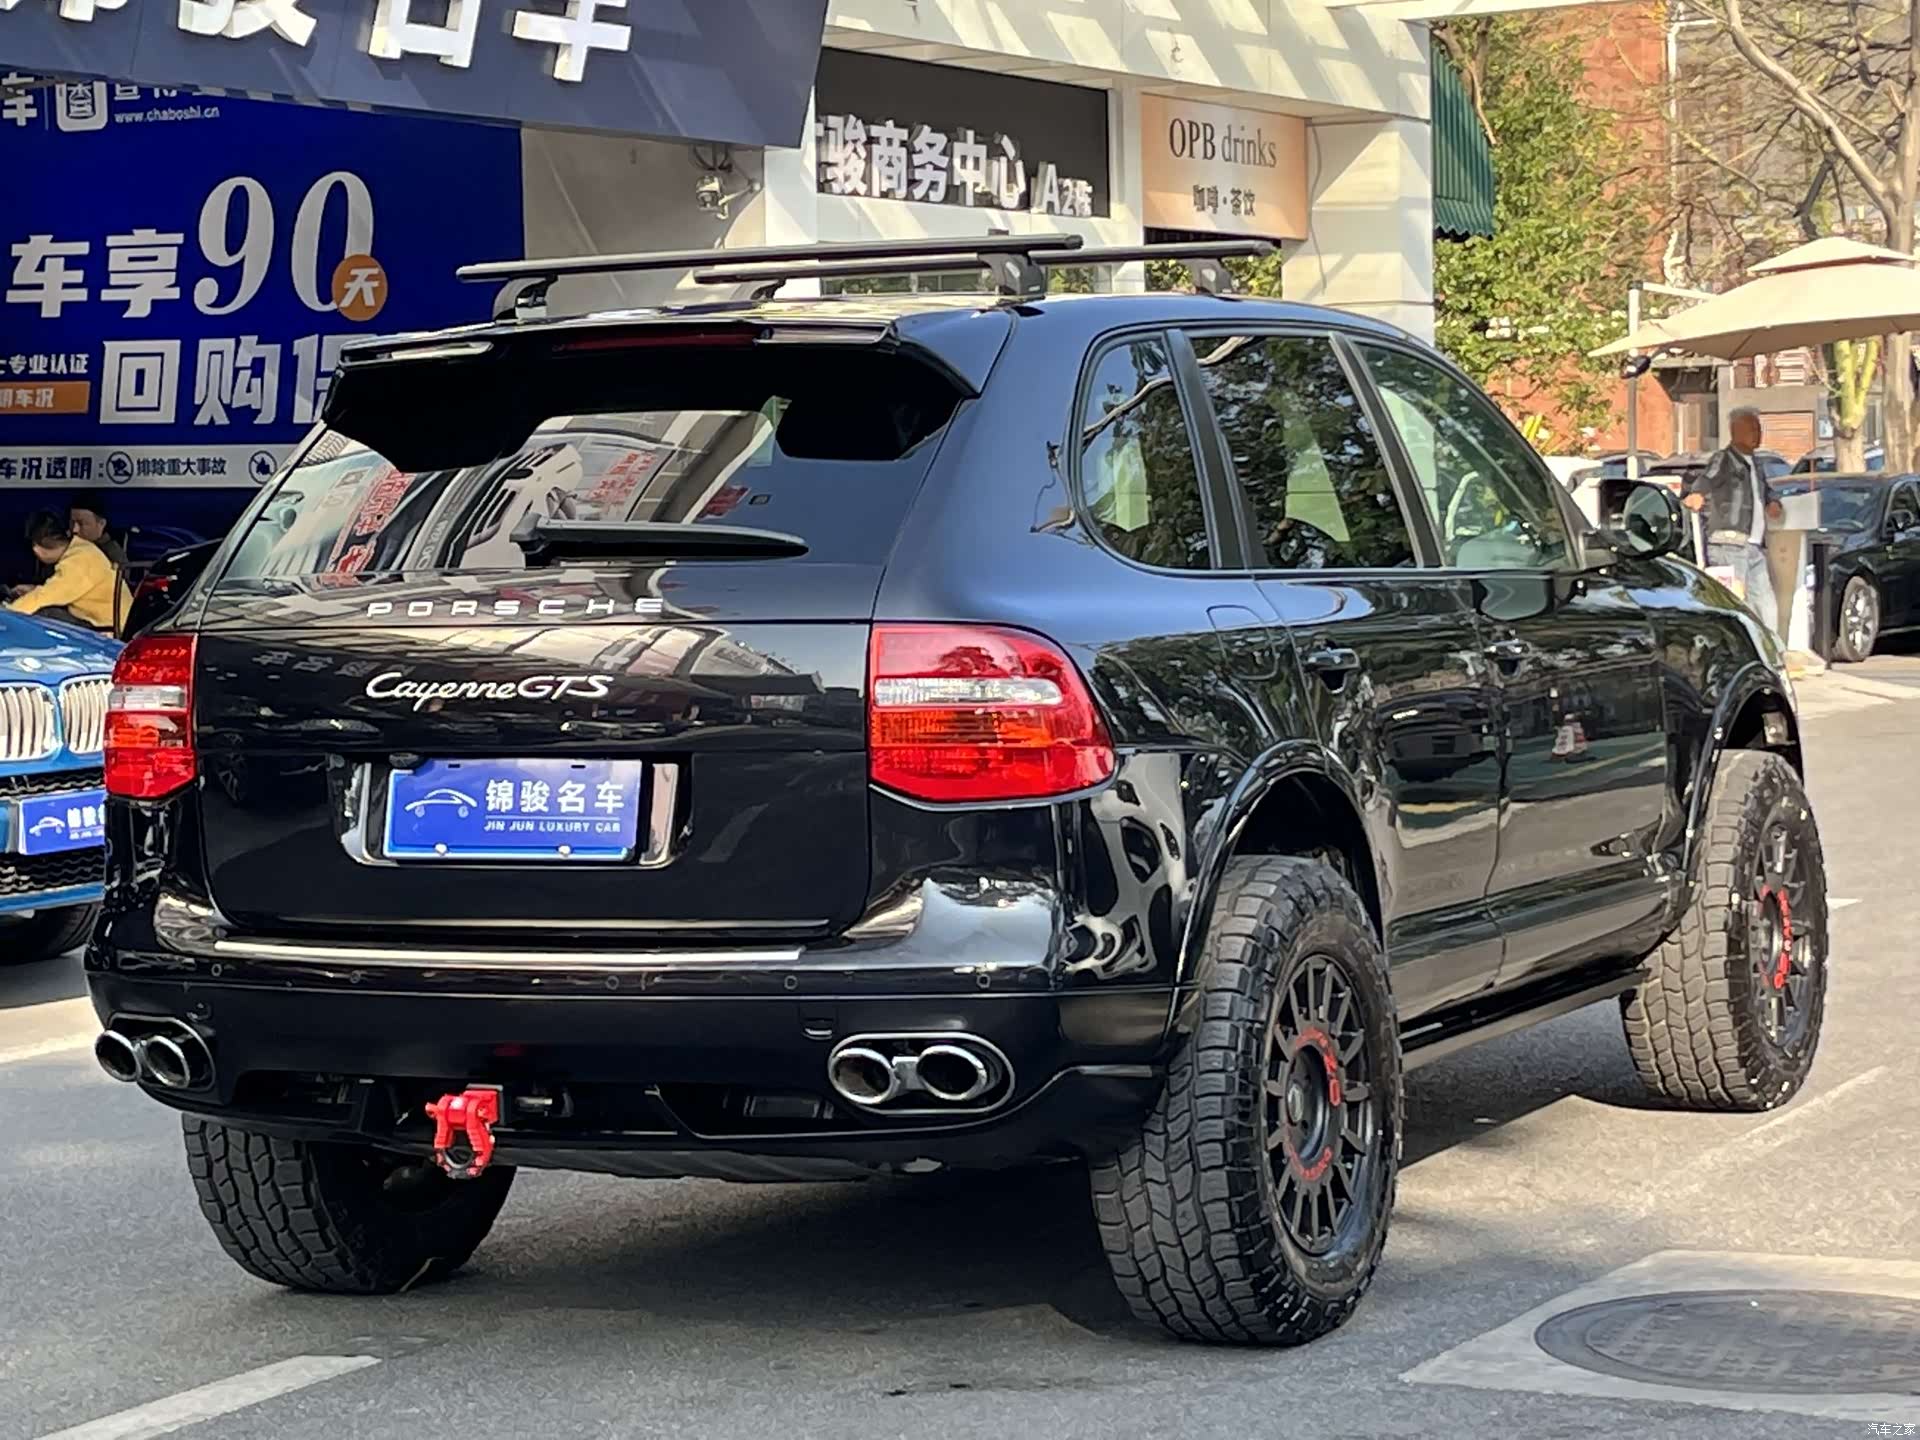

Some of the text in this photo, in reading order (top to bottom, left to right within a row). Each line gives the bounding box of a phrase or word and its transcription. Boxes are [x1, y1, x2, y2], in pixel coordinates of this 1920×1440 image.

[114, 105, 220, 123] www.chaboshi.cn
[1169, 118, 1277, 169] OPB drinks
[815, 114, 1026, 209] 骏商务中心
[366, 597, 664, 618] PORSCHE
[485, 779, 625, 815] 锦骏名车
[484, 819, 621, 833] JIN JUN LUXURY CAR
